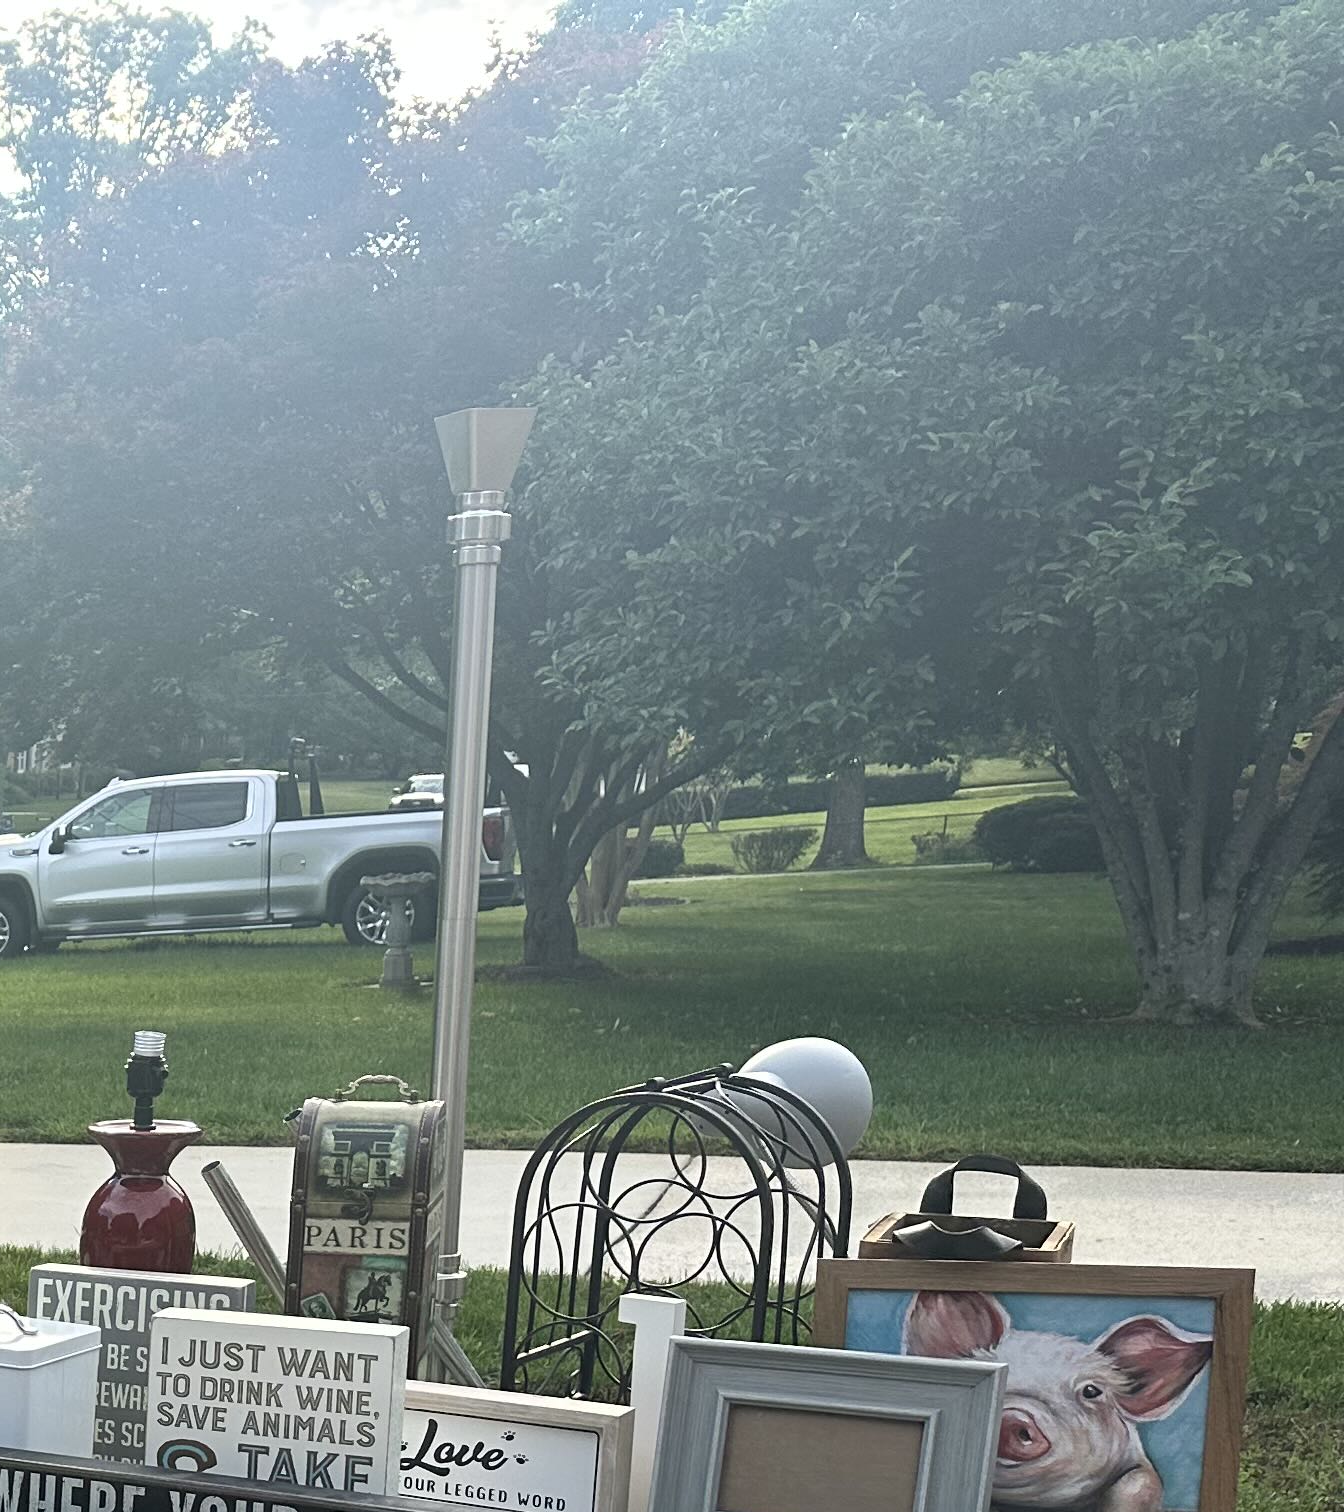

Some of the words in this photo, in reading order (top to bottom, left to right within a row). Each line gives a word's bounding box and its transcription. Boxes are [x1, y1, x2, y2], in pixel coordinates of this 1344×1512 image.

[305, 1224, 407, 1250] PARIS
[161, 1336, 169, 1365] I
[178, 1338, 265, 1373] JUST
[277, 1346, 379, 1384] WANT
[156, 1371, 191, 1398] TO
[200, 1376, 284, 1408] DRINK
[295, 1385, 381, 1420] WINE,
[156, 1401, 227, 1432] SAVE
[241, 1410, 376, 1448] ANIMALS
[400, 1418, 509, 1477] Love
[237, 1443, 374, 1492] TAKE
[403, 1476, 436, 1493] OUR
[444, 1482, 508, 1503] LEGGED
[518, 1492, 567, 1512] WORD
